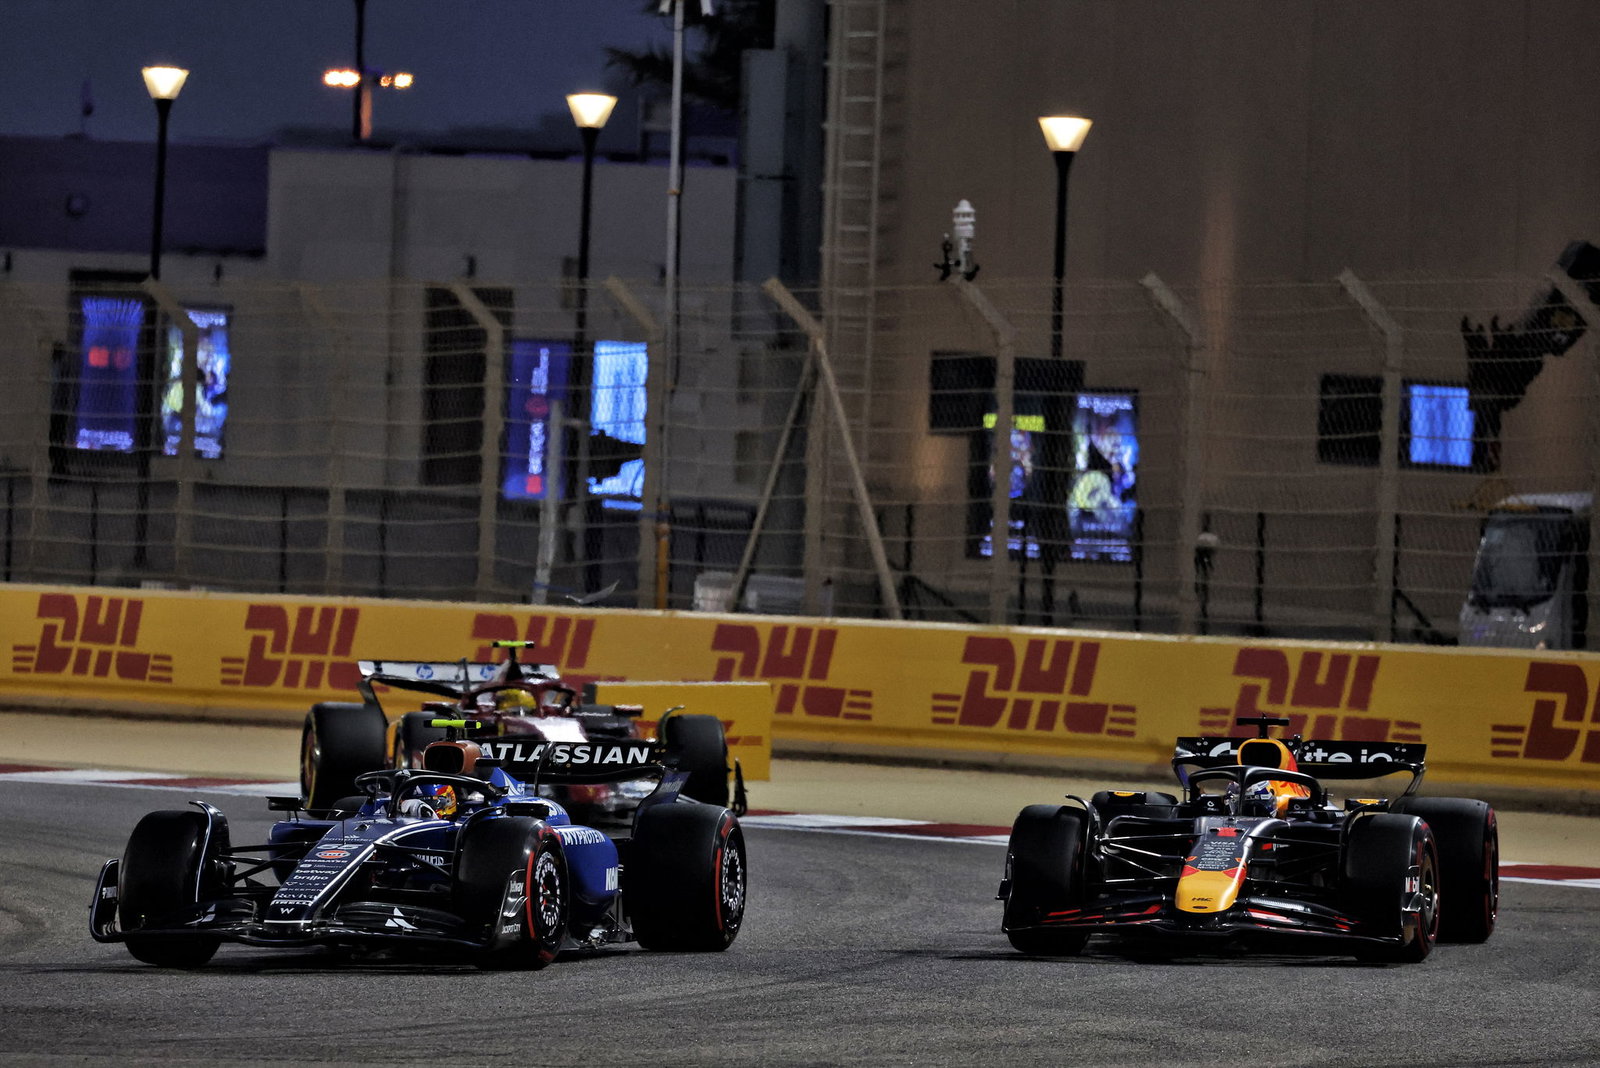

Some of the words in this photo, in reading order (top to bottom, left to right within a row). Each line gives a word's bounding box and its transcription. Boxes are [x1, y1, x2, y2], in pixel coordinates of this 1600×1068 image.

[34, 593, 150, 681] DHL
[244, 604, 360, 690] DHL
[958, 635, 1109, 735] DHL
[480, 742, 650, 764] ATLASSIAN
